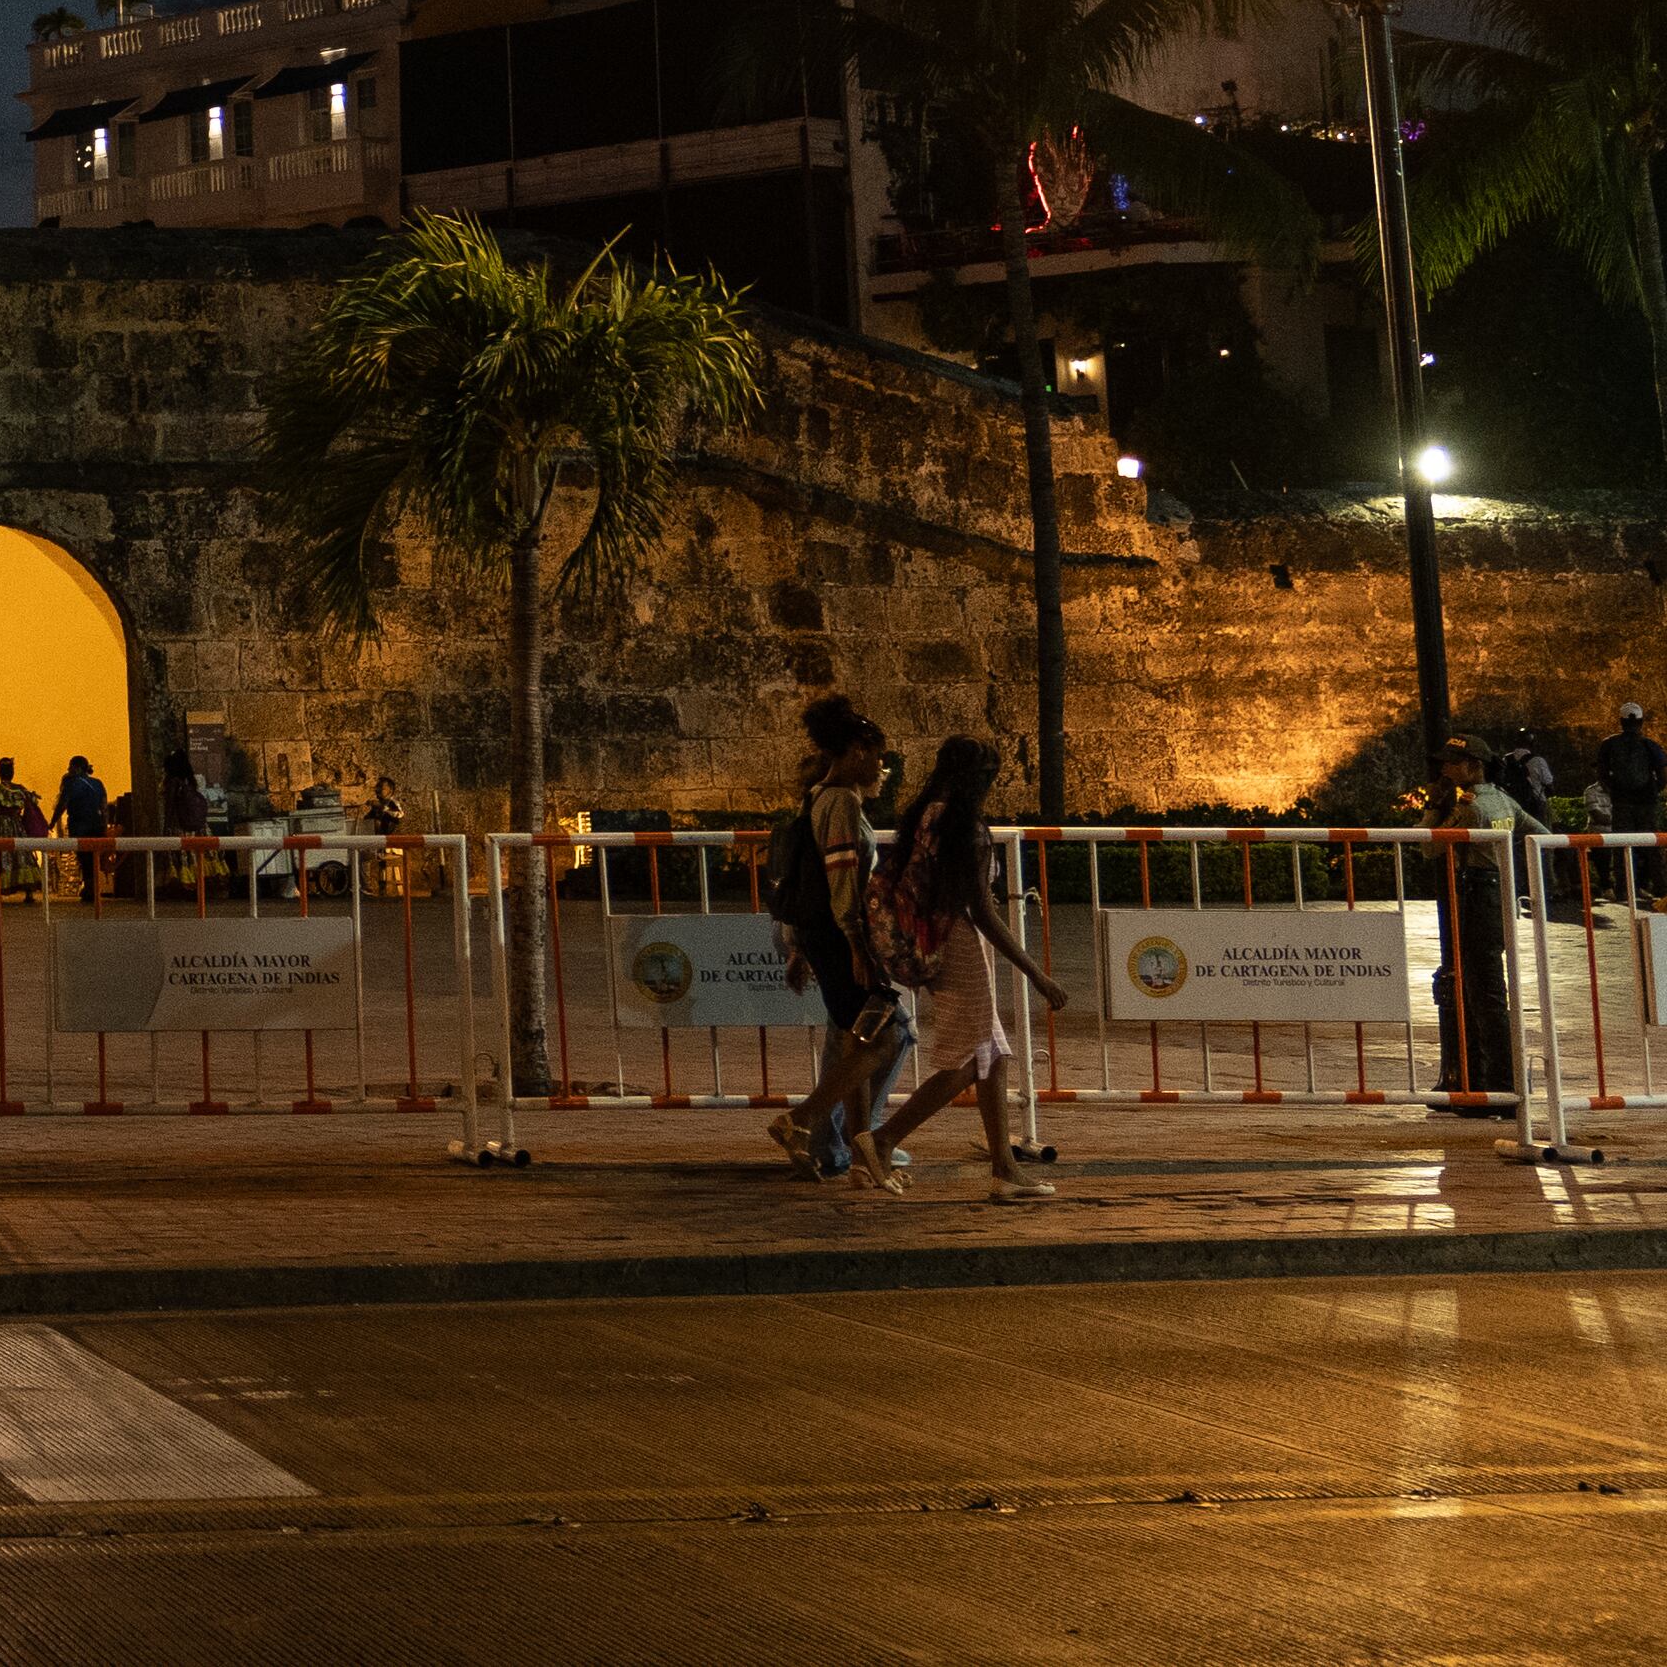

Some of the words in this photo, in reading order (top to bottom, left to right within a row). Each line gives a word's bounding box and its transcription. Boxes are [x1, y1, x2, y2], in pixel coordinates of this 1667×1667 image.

[170, 952, 249, 968] ALCALDÍA
[252, 954, 311, 968] MAYOR
[727, 952, 787, 966] ALCALD
[1222, 945, 1301, 961] ALCALDÍA
[1304, 947, 1362, 960] MAYOR
[700, 970, 721, 983] DE
[725, 970, 784, 982] CARTAG
[1196, 965, 1217, 977] DE
[1220, 964, 1310, 978] CARTAGENA
[1315, 964, 1335, 976] DE
[1339, 965, 1392, 977] INDIAS
[169, 972, 258, 985] CARTAGENA
[262, 972, 282, 984] DE
[287, 972, 340, 984] INDIAS
